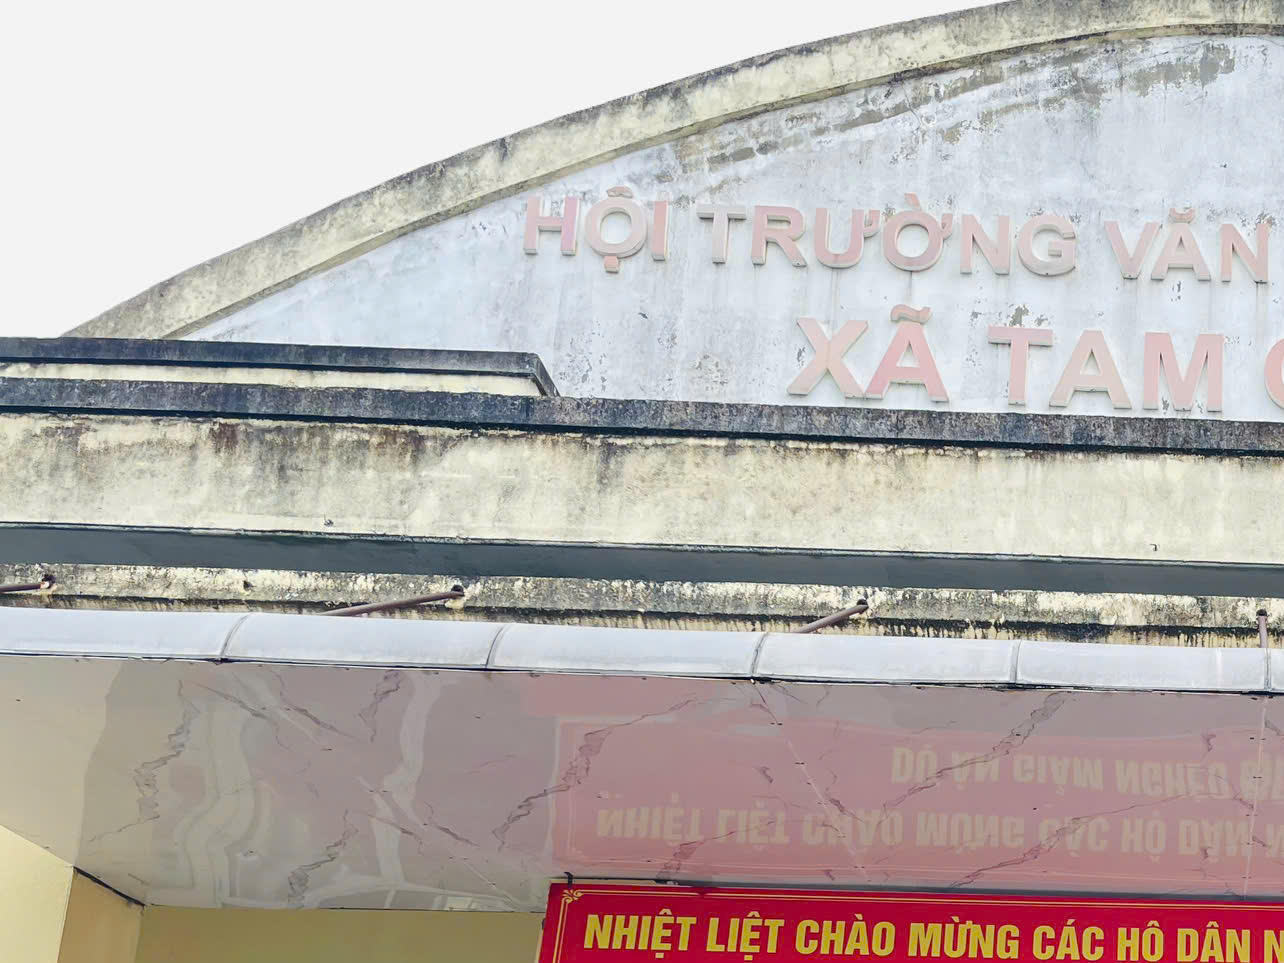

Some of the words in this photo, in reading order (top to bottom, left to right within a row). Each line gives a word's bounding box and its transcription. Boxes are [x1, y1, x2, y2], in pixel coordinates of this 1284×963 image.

[524, 186, 669, 273] HỘI
[699, 193, 1077, 277] TRƯỜNG
[1104, 207, 1270, 285] VĂN
[787, 304, 950, 403] XÃ
[987, 326, 1224, 413] TAM
[583, 909, 694, 958] NHIỆT
[706, 912, 785, 960] LIỆT
[795, 914, 896, 957] CHÀO
[907, 916, 1020, 961] MỪNG
[1032, 919, 1105, 962] CÁC
